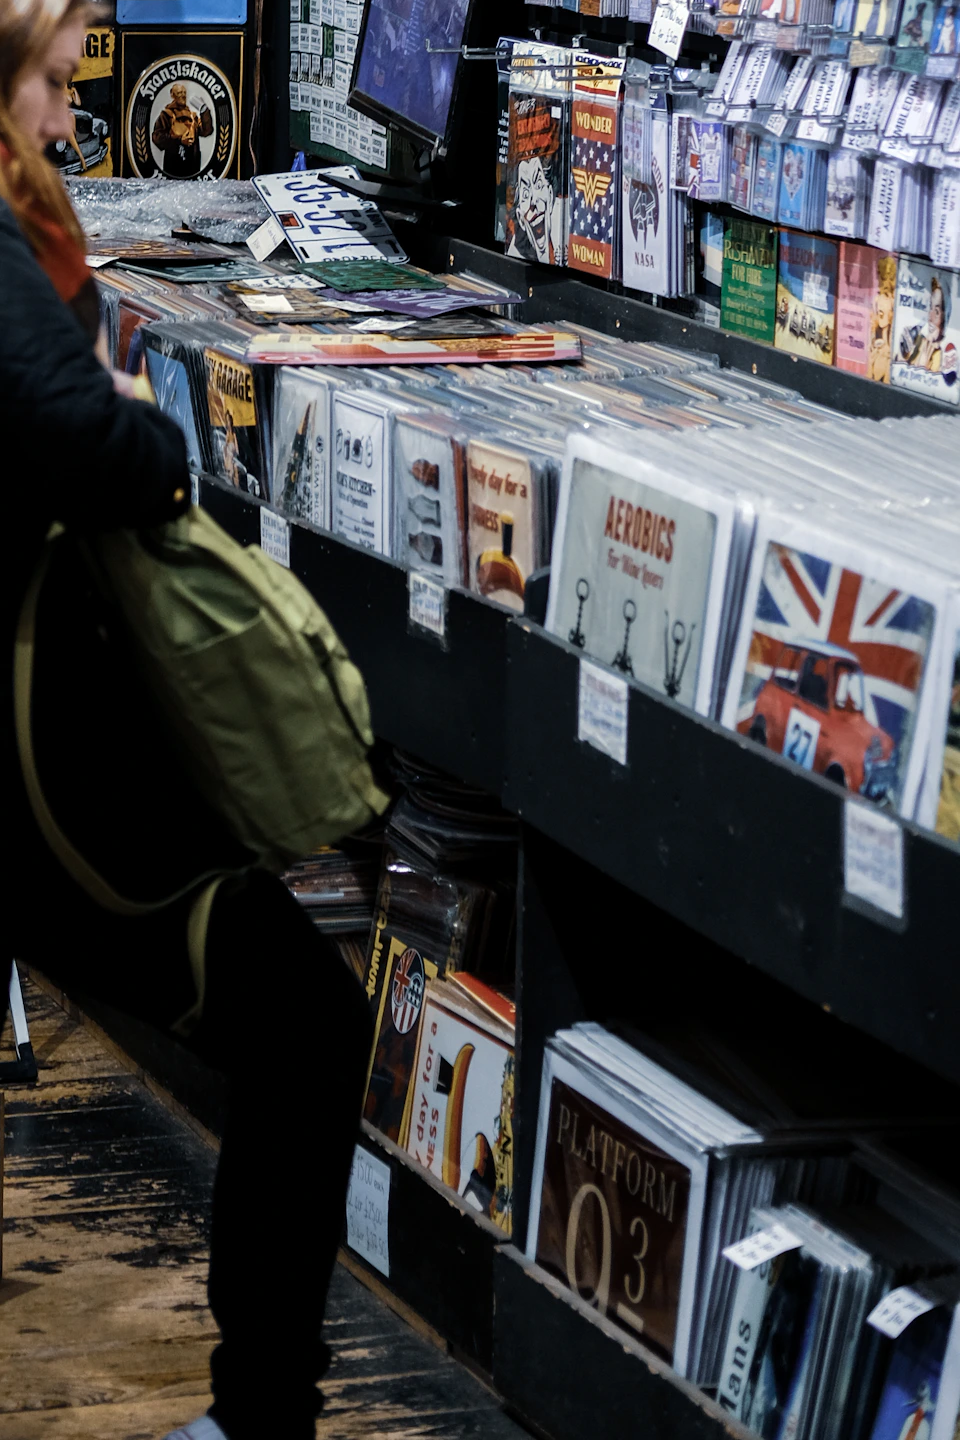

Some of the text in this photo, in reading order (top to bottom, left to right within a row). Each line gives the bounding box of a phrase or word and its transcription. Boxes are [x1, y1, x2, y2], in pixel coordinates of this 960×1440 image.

[140, 61, 226, 101] Franziskaner
[575, 111, 613, 134] WONDER
[572, 242, 605, 268] WOMAN
[634, 252, 655, 269] NASA
[732, 265, 762, 287] FOR HIRE
[217, 361, 252, 404] GARAGE
[504, 473, 518, 497] for
[605, 494, 676, 565] AEROBICS
[421, 1046, 437, 1082] for
[415, 1091, 430, 1138] day
[556, 1102, 678, 1223] PLATFORM
